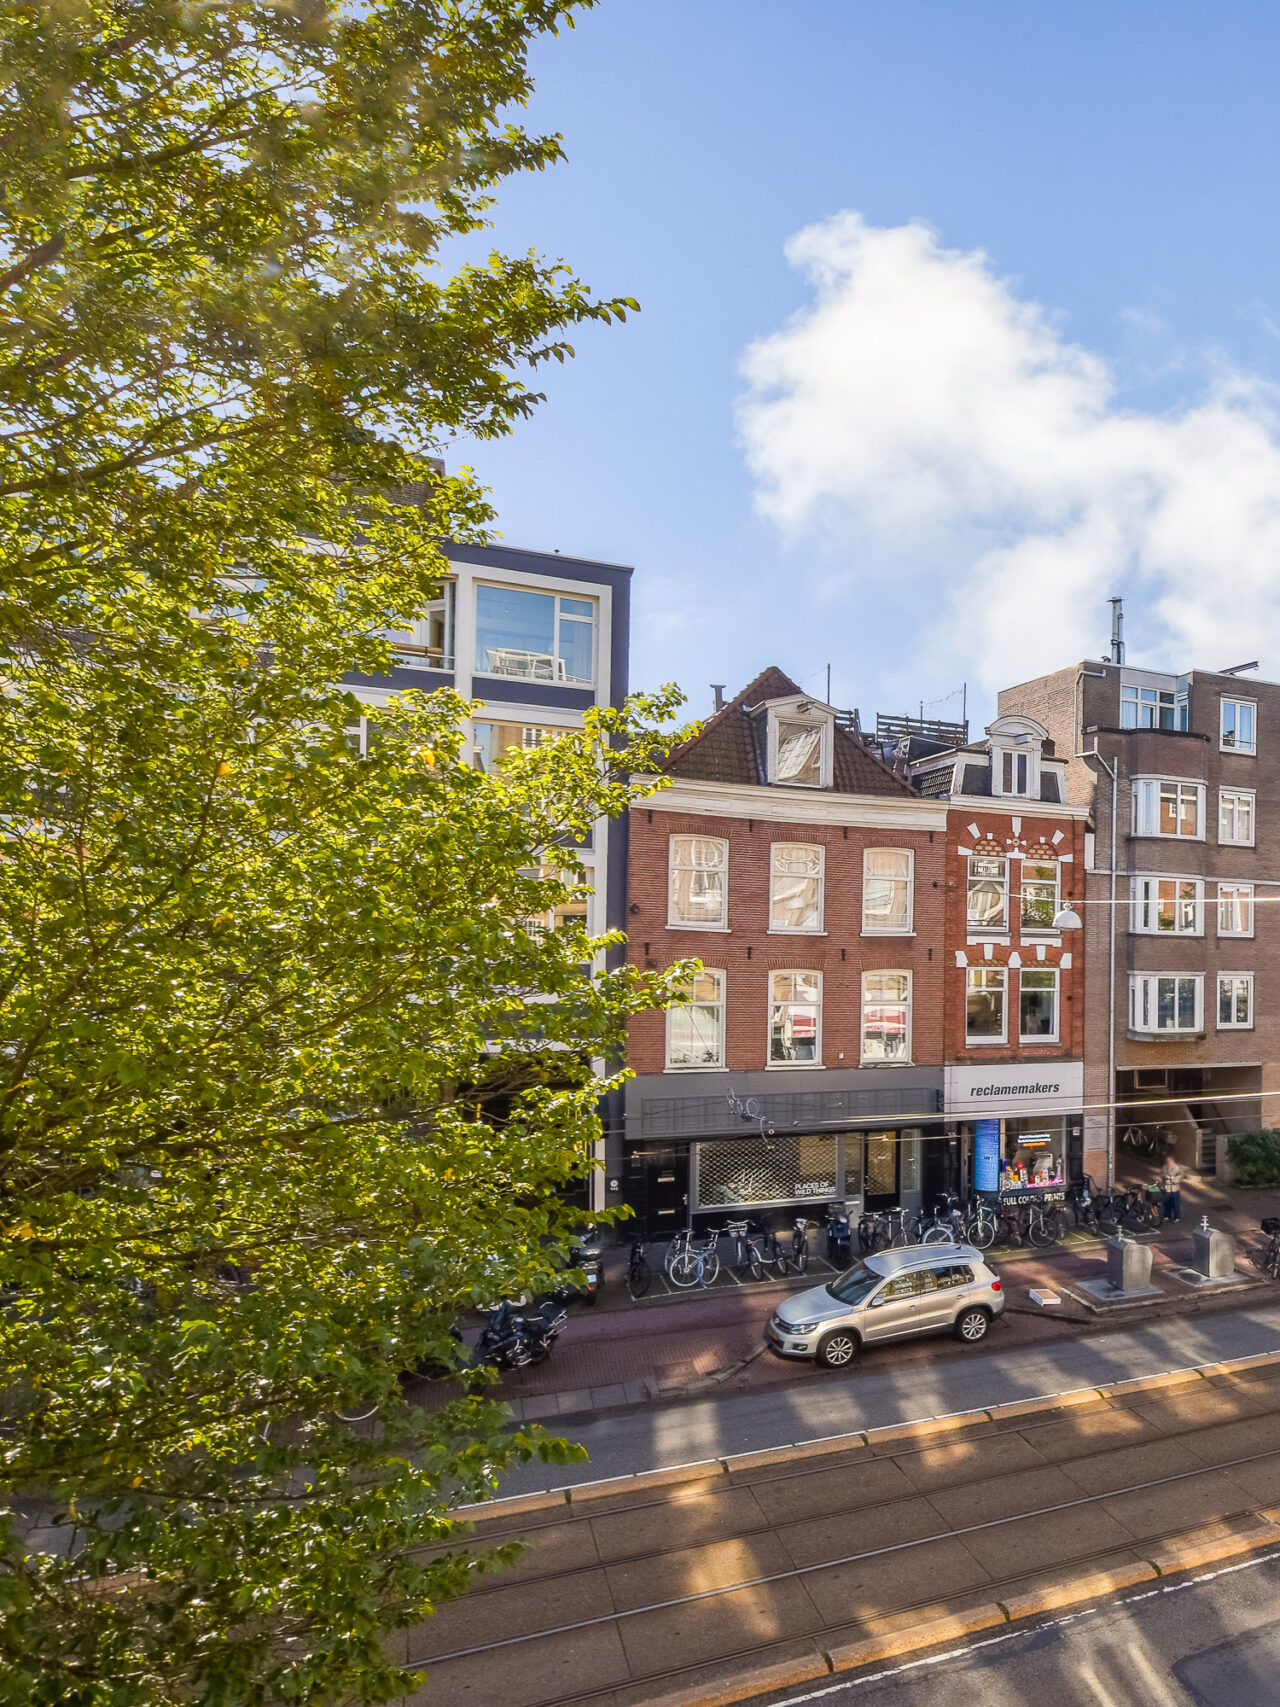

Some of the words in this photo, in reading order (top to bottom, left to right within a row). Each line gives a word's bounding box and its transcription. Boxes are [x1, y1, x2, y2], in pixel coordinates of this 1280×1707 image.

[970, 1082, 1060, 1097] reclamemakers
[794, 1182, 819, 1190] PLACES
[795, 1188, 812, 1196] WILD
[813, 1186, 836, 1195] THINGS
[1002, 1196, 1017, 1206] FULL
